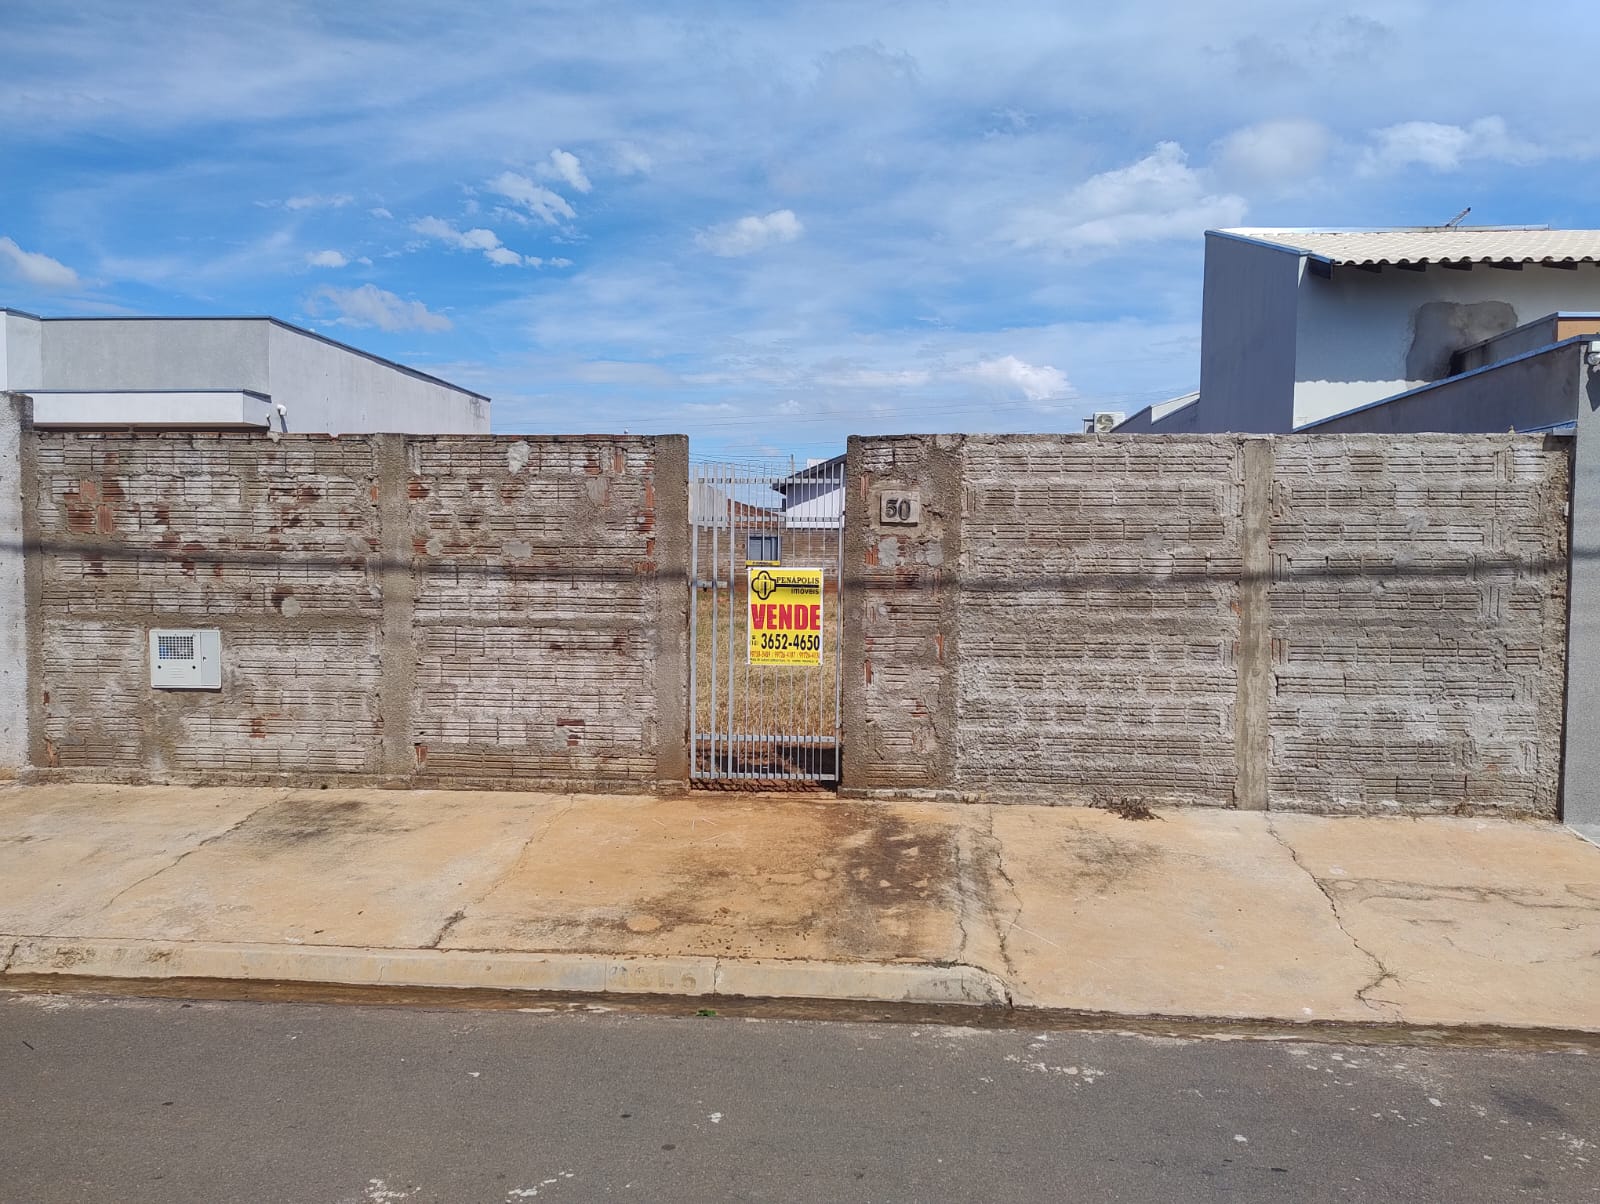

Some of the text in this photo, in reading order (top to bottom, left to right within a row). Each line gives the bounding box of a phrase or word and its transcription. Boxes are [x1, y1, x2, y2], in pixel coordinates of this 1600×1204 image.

[885, 498, 911, 521] 50
[751, 604, 821, 630] VENDE
[761, 633, 820, 651] 3652-4650
